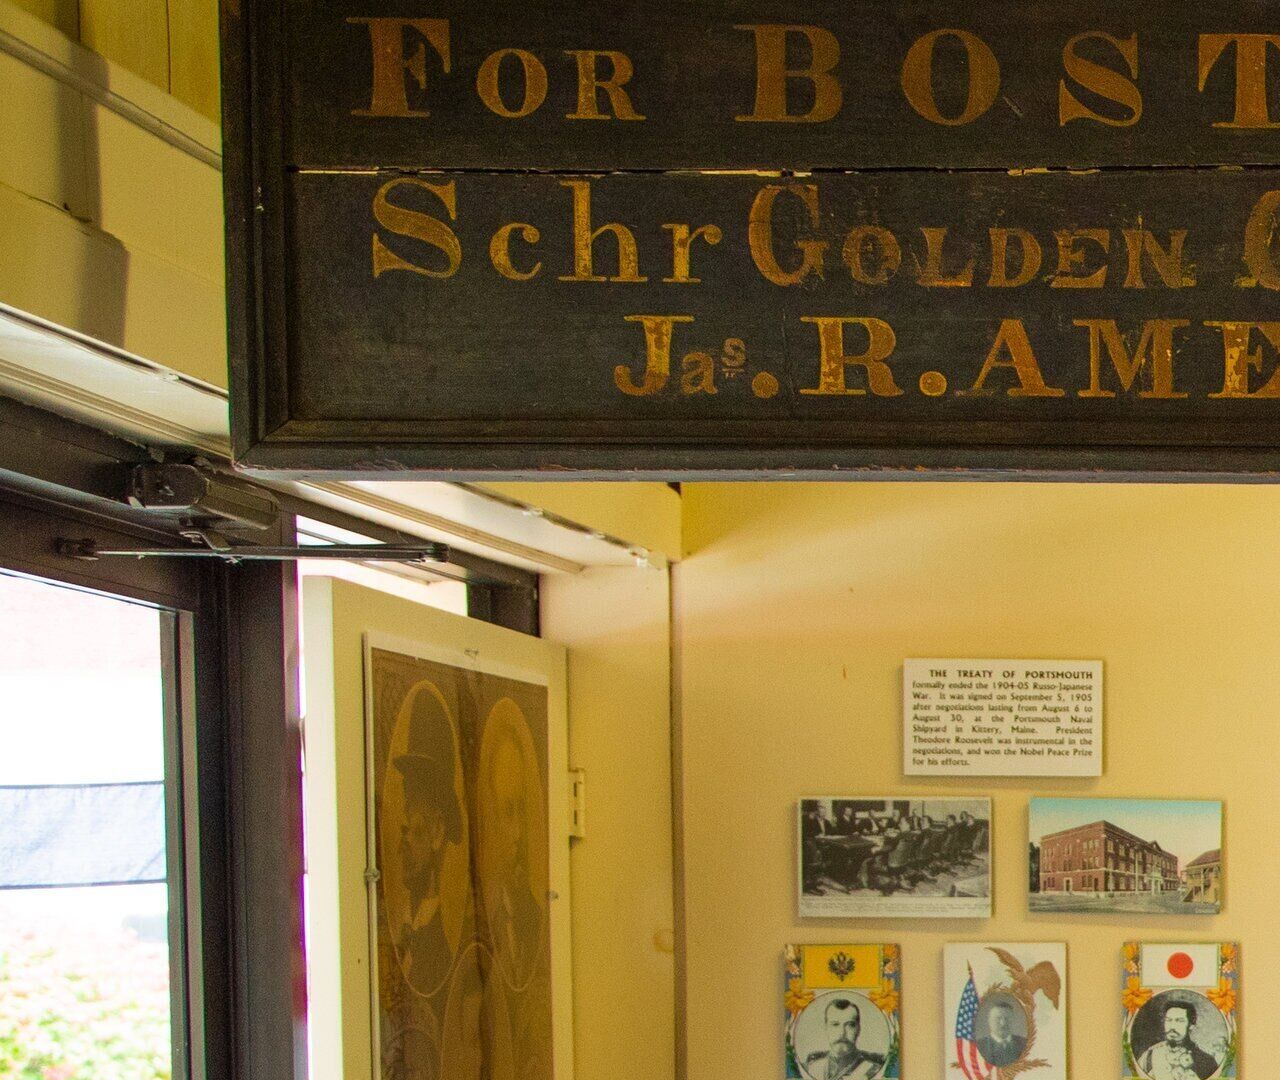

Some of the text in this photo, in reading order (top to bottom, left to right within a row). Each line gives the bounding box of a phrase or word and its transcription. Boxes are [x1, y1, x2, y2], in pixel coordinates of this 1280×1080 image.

[371, 177, 723, 284] Schr
[747, 183, 1197, 290] GOLDEN
[930, 669, 1093, 679] THE TREATY OF PORTSMOUTH
[912, 681, 945, 690] formally
[949, 681, 972, 689] ended
[993, 682, 1029, 690] 1904-05
[968, 693, 993, 702] signed
[1010, 693, 1053, 703] September
[1070, 694, 1092, 702] 1905
[912, 703, 931, 711] after
[935, 703, 984, 713] negotiations
[988, 704, 1013, 713] lasting
[1018, 704, 1037, 712] from
[1042, 704, 1070, 714] August
[912, 714, 940, 724] August
[950, 715, 964, 723] 30,
[1014, 715, 1060, 723] Portsmouth
[1071, 715, 1092, 723] Naval
[913, 725, 947, 735] Shipyard
[972, 726, 1002, 735] Kittery,
[1011, 726, 1038, 734] Maine.
[1056, 726, 1092, 734] President
[913, 736, 950, 744] Theodore
[1015, 737, 1065, 745] instrumental
[1068, 737, 1076, 745] in
[1080, 737, 1092, 745] the
[912, 748, 963, 757] negotiations,
[1004, 748, 1017, 756] the
[1020, 748, 1044, 756] Nobel
[1047, 748, 1069, 756] Peace
[912, 758, 925, 766] for
[927, 758, 938, 766] his
